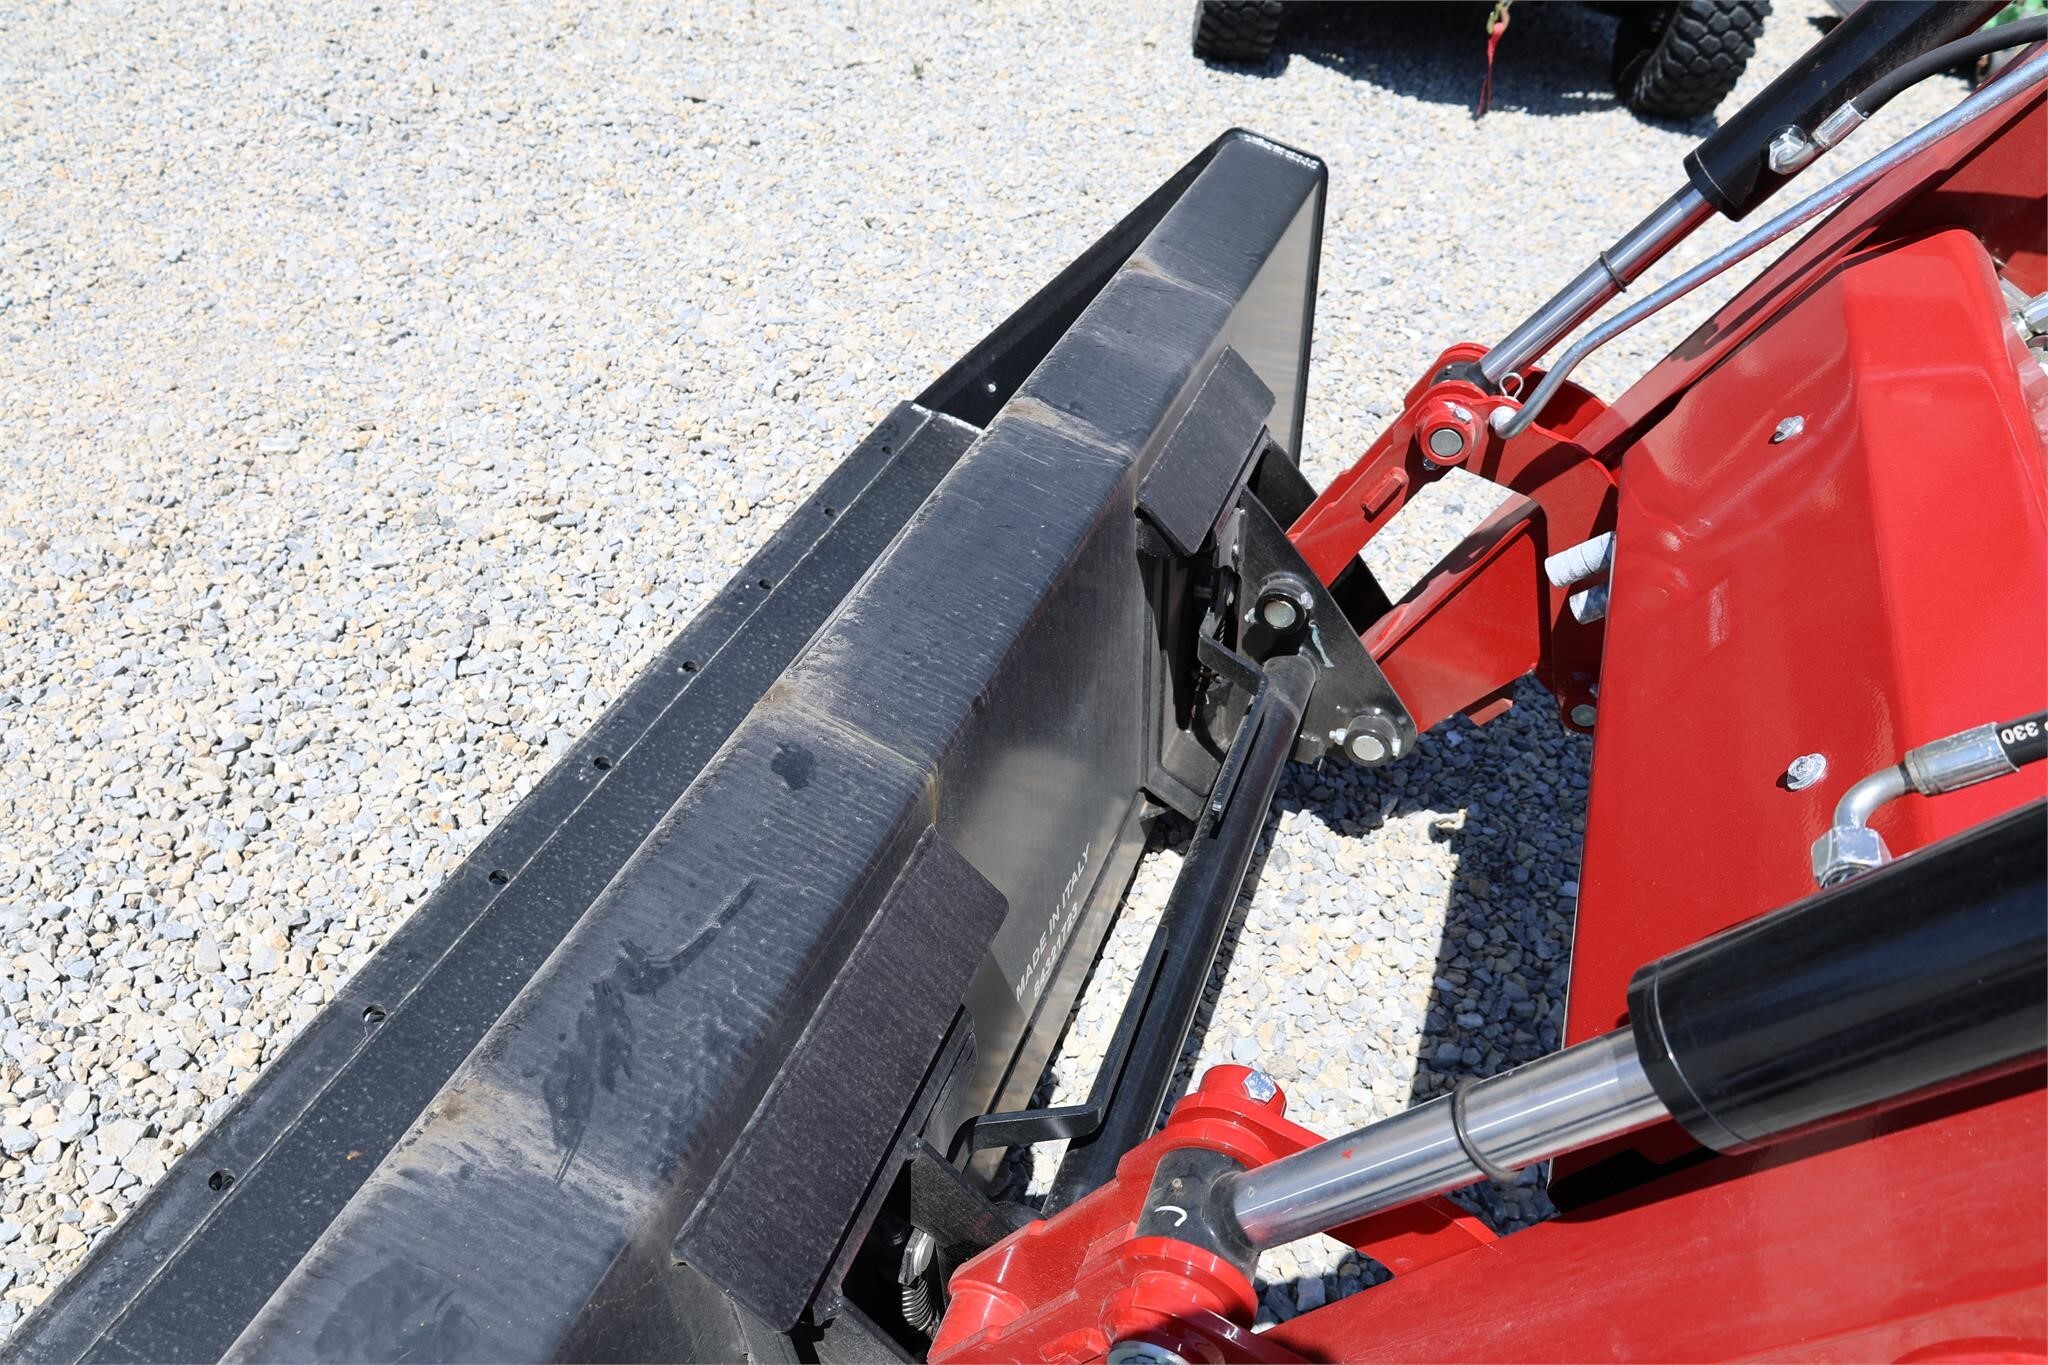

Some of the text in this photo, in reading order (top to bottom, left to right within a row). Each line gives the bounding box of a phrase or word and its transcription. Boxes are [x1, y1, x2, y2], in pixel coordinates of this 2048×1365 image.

[2001, 722, 2039, 744] 330
[1016, 842, 1090, 1002] MADE IN ITALY
